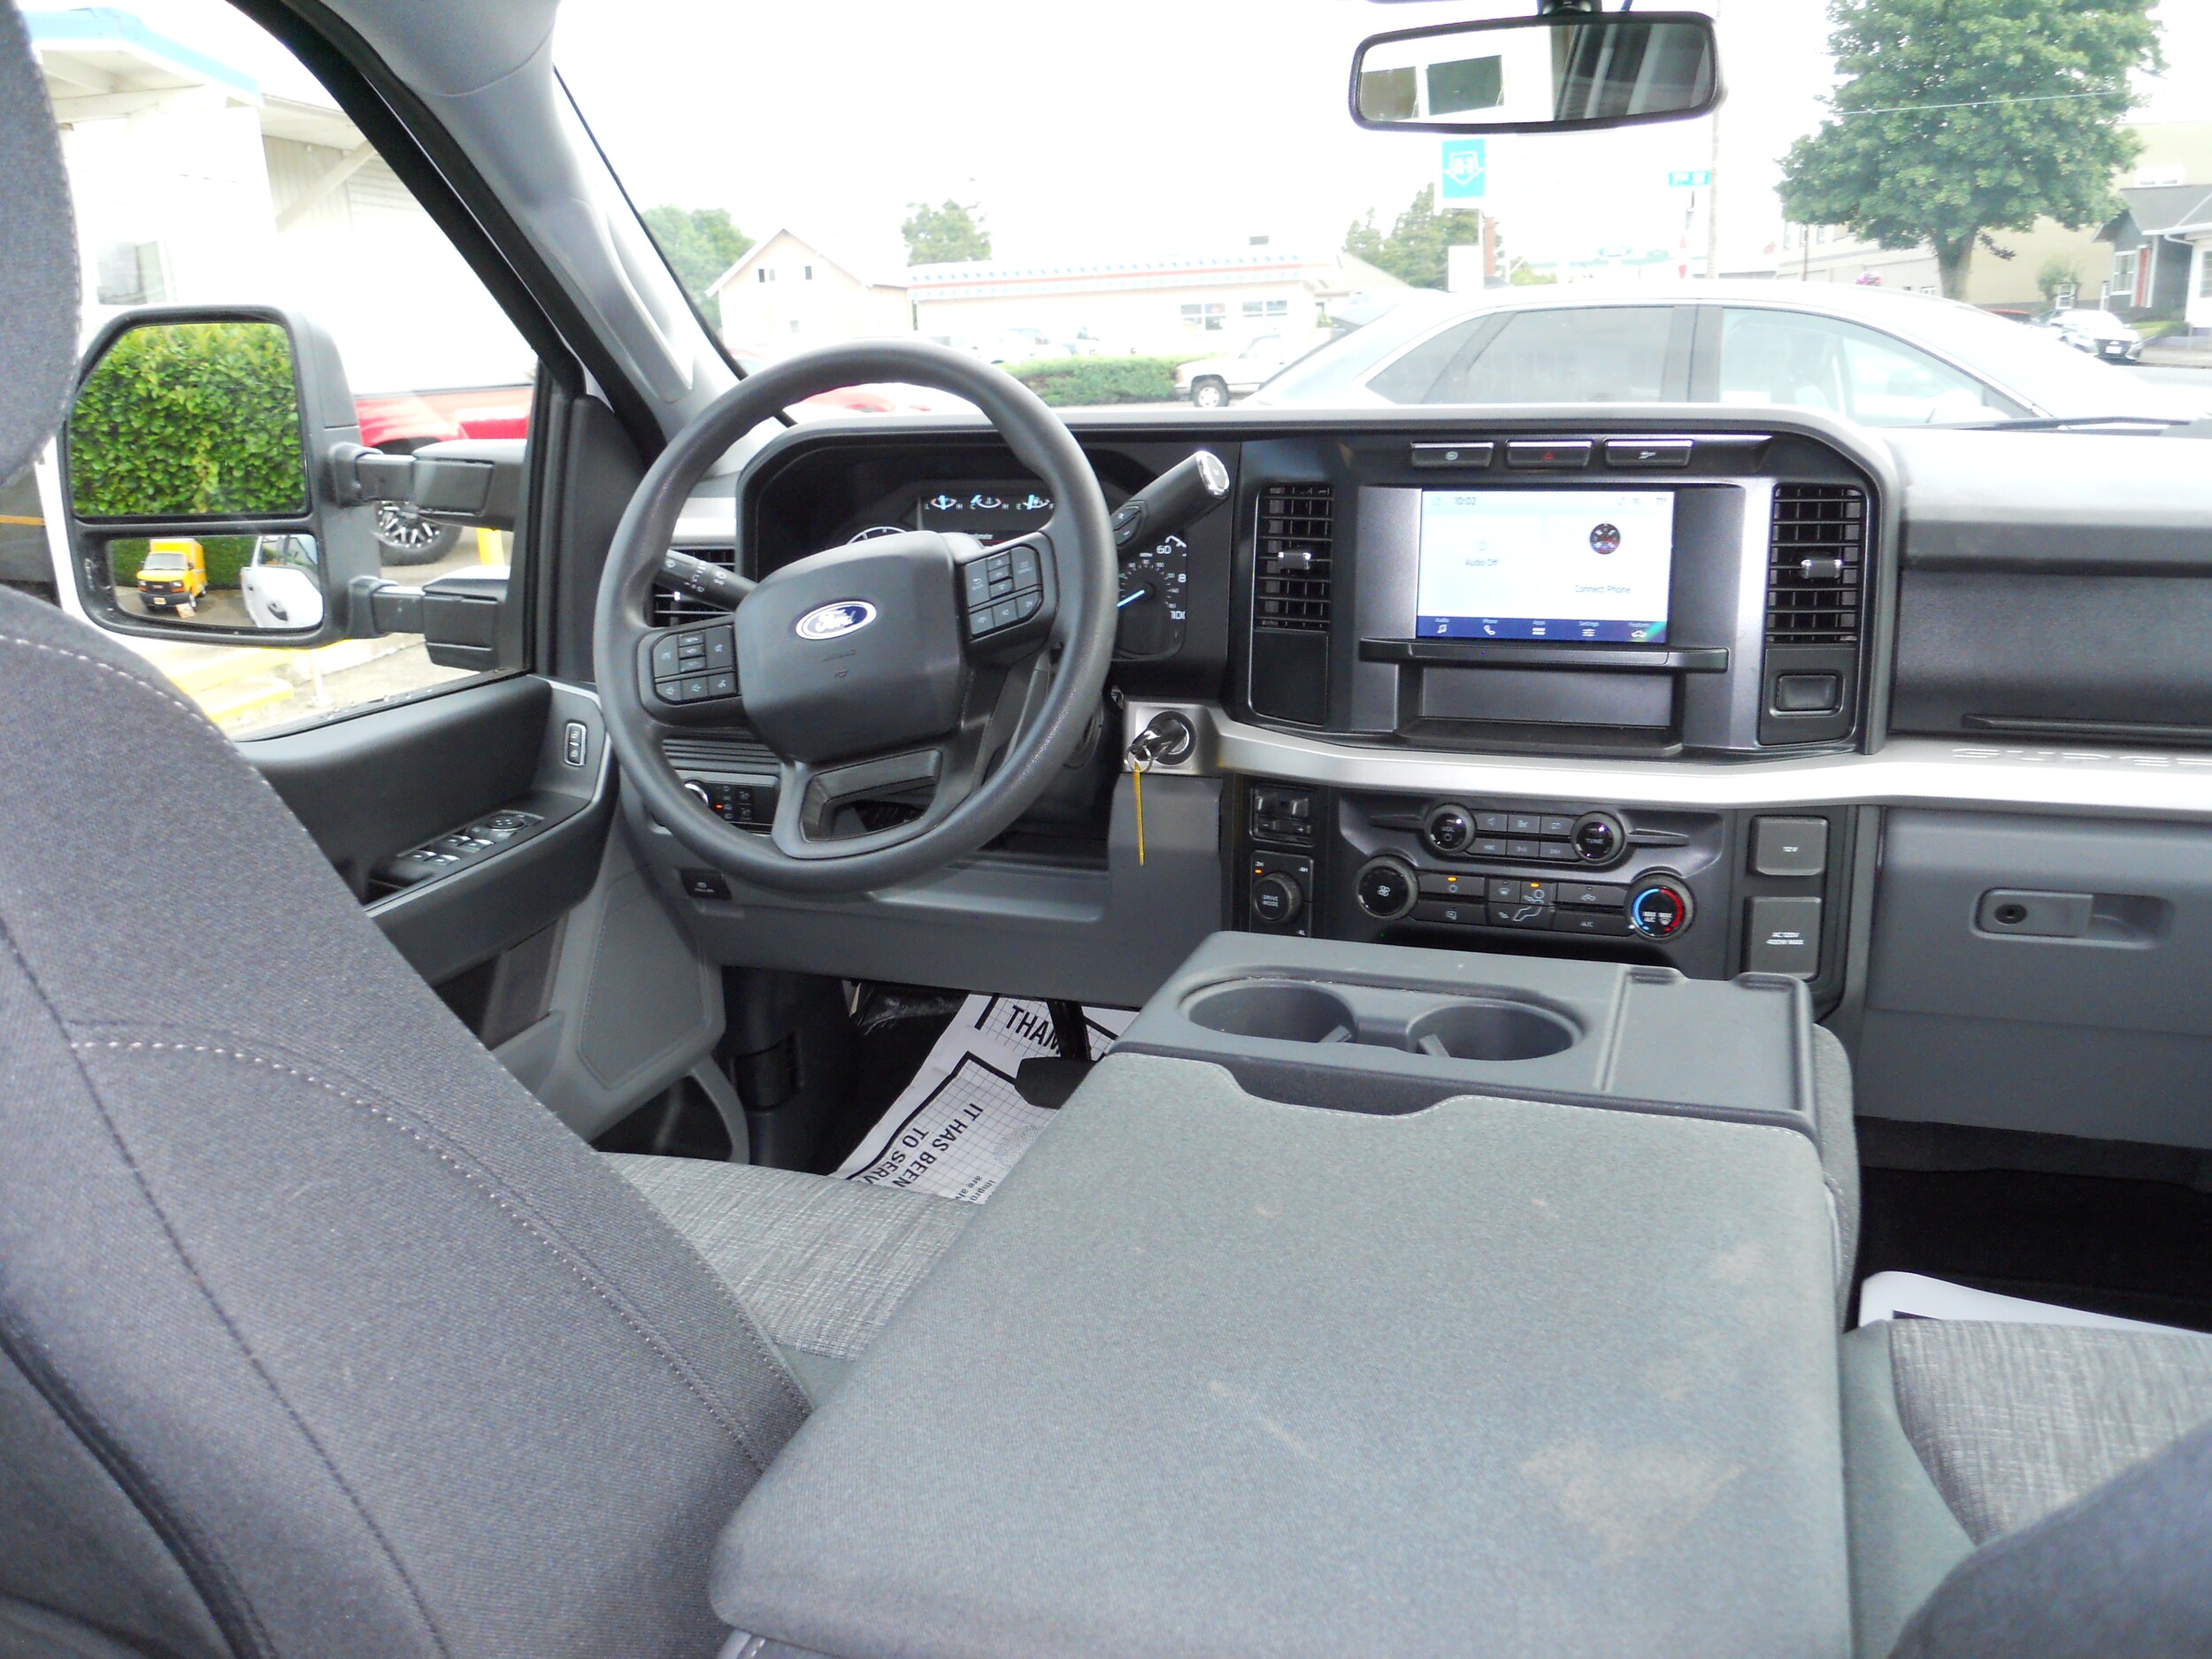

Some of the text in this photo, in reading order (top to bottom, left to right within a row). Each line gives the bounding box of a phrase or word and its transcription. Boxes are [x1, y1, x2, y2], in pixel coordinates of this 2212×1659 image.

[1156, 545, 1172, 555] 60
[1005, 1005, 1061, 1056] THAN
[857, 1127, 930, 1185] TO SERV
[892, 1102, 984, 1187] IT HAS BEEN
